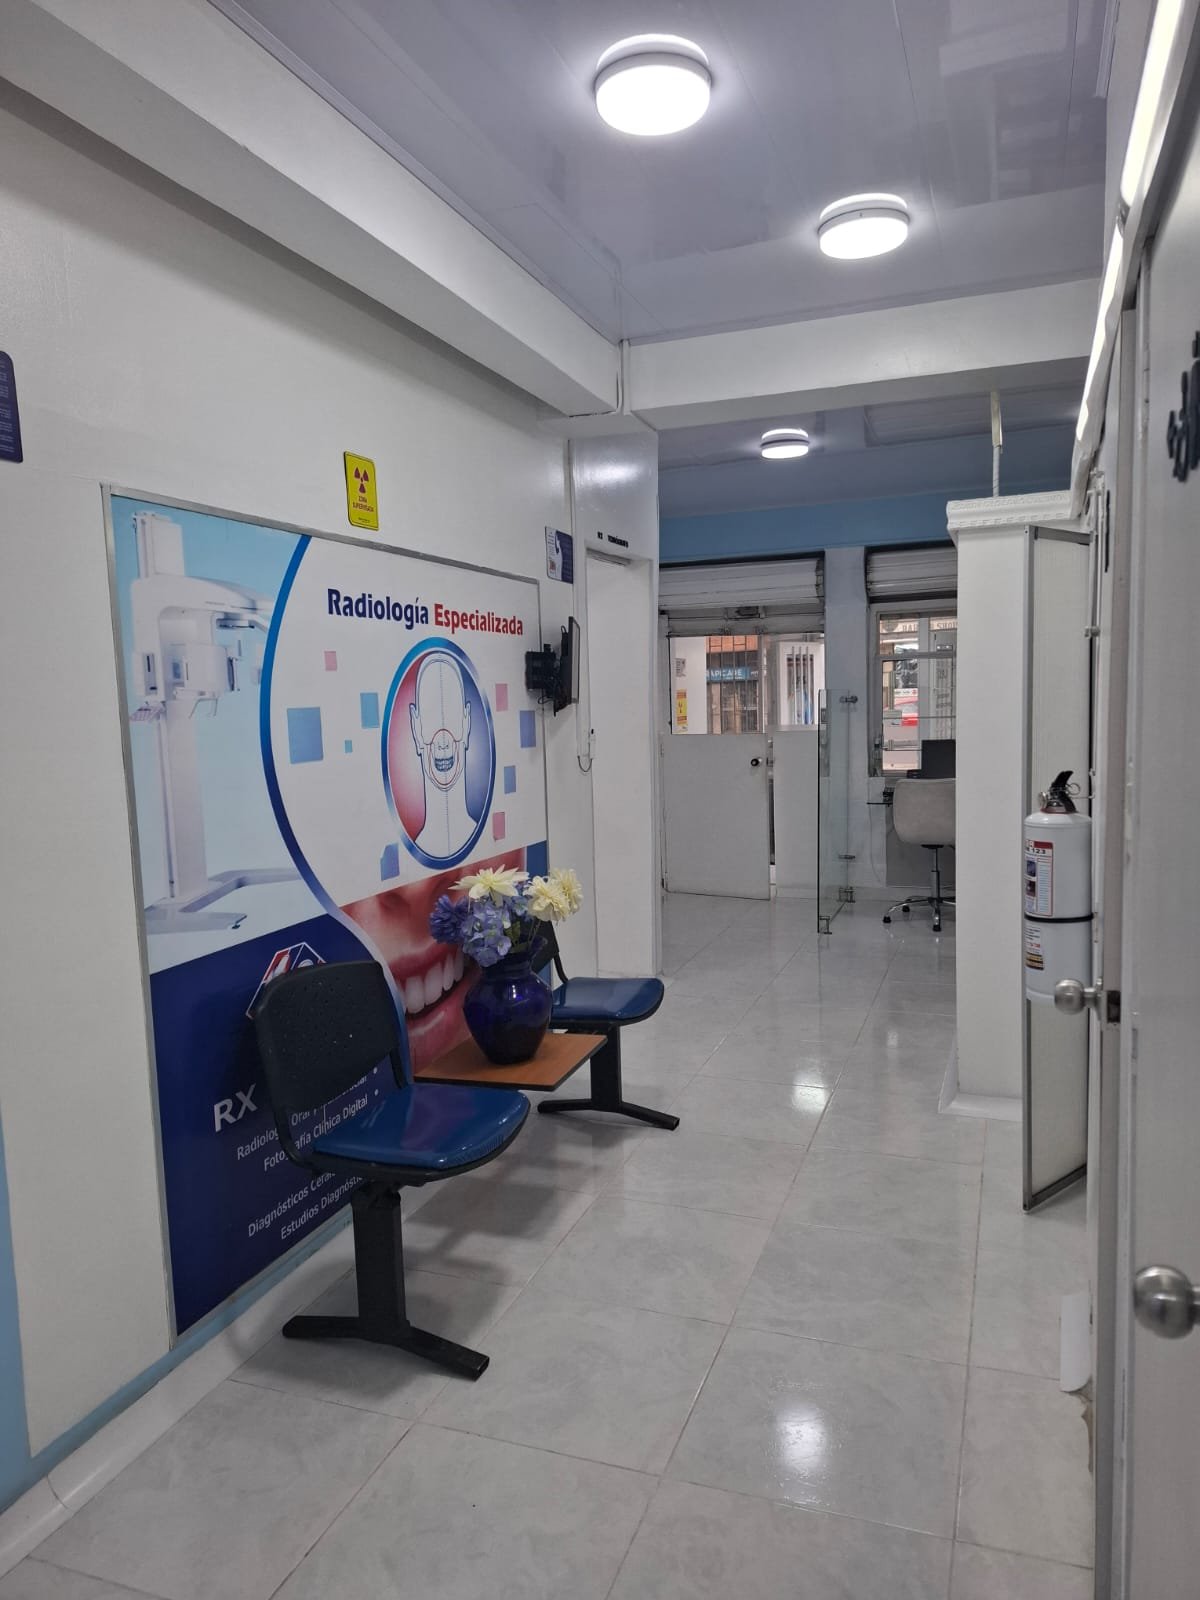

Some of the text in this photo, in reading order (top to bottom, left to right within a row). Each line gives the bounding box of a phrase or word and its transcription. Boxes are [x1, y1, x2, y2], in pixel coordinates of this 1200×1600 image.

[327, 588, 524, 635] Radiología Especializada
[213, 1083, 259, 1133] RX
[263, 1132, 312, 1172] Fotoafía
[342, 1092, 368, 1120] Digital
[248, 1186, 309, 1238] Diagnósticos
[280, 1204, 319, 1240] Estudios
